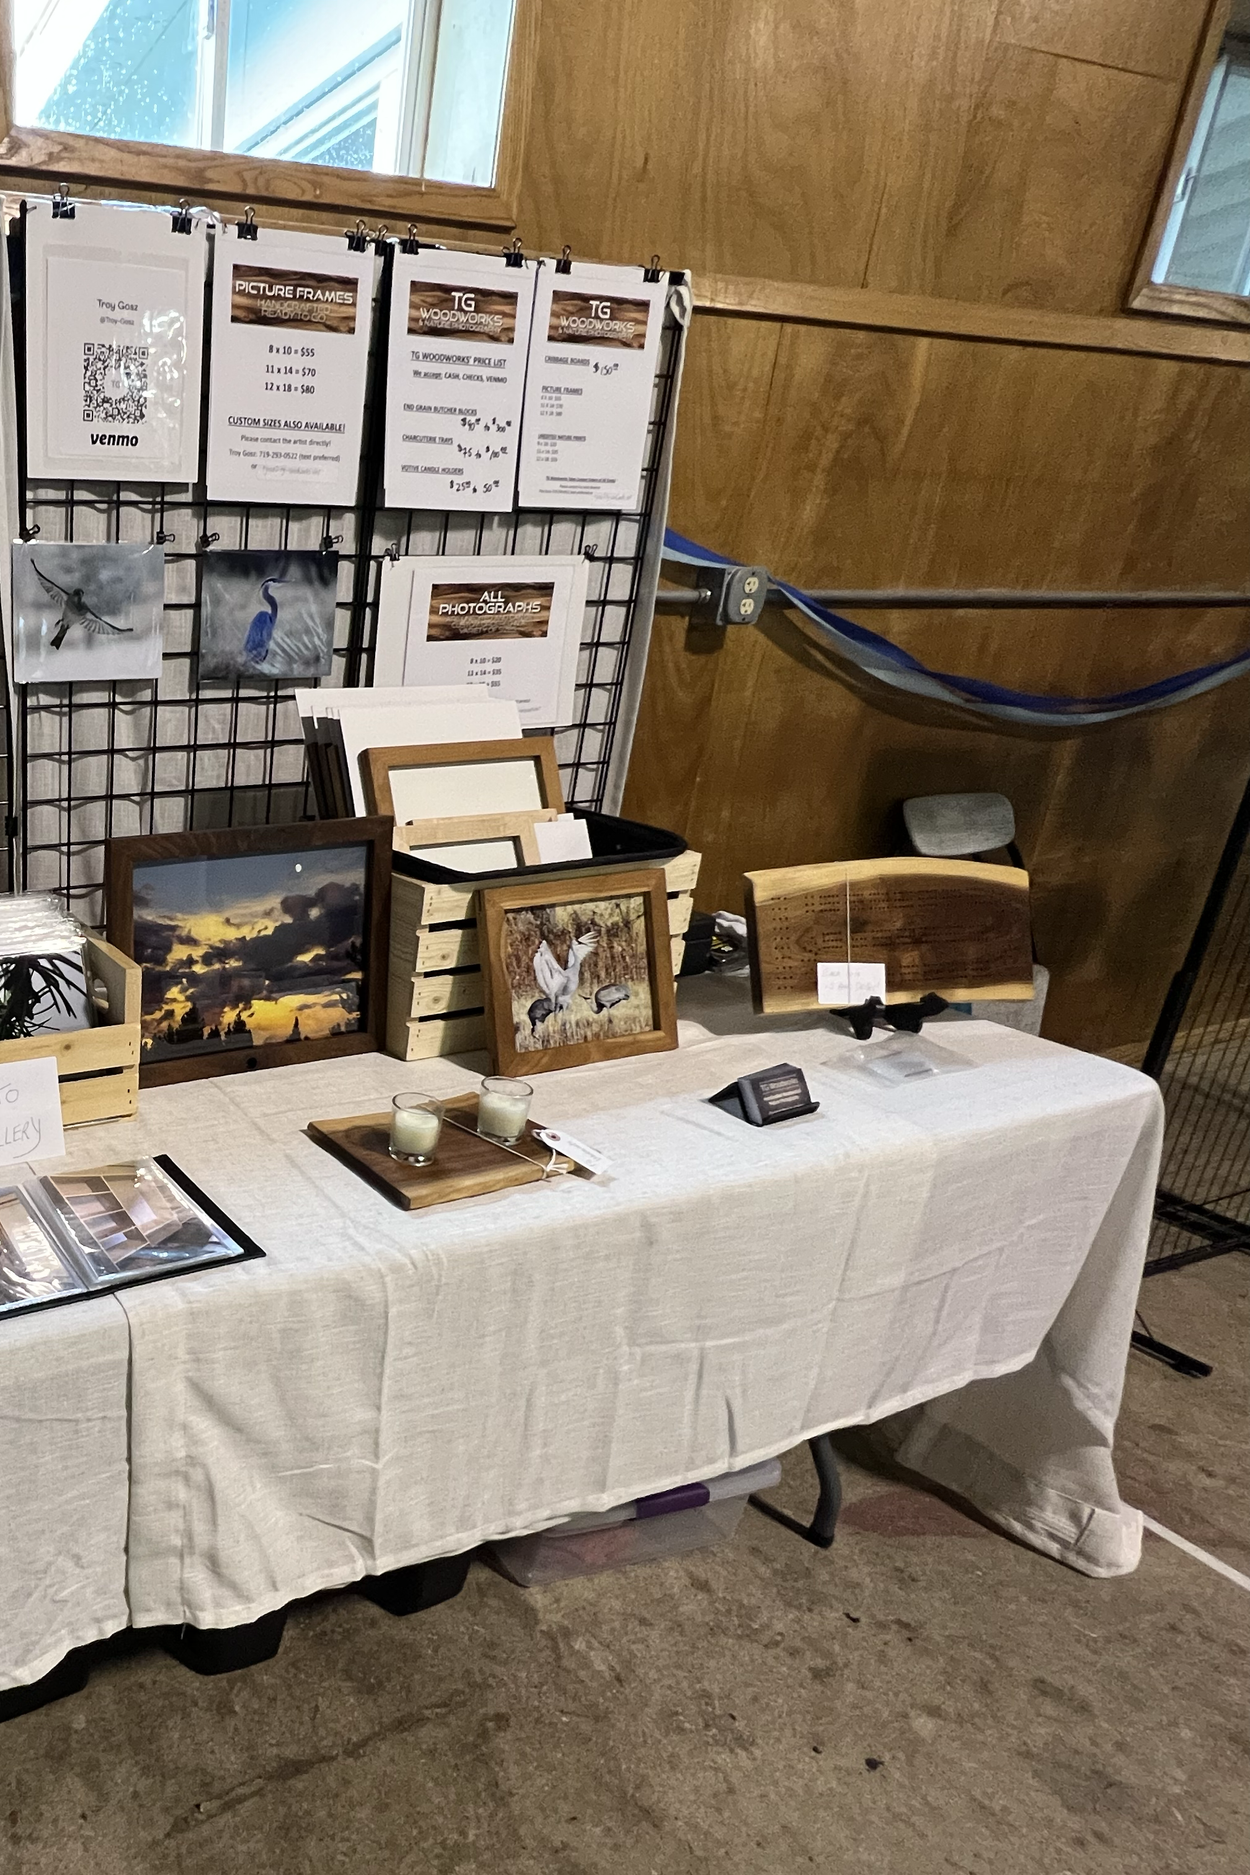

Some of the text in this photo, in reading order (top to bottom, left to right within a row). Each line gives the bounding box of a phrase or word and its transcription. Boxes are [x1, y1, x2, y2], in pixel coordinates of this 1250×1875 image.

[235, 281, 353, 304] PICTURE FRAMES
[97, 299, 138, 311] Troy Gosz
[451, 291, 476, 311] TG
[589, 300, 611, 319] TG
[419, 307, 503, 326] WOODWORKS
[560, 316, 635, 332] WOODWORKS
[268, 344, 274, 354] 8
[283, 345, 292, 355] 10
[301, 346, 315, 357] $55
[411, 351, 420, 359] TG
[473, 356, 492, 366] PRICE
[493, 359, 507, 367] LIST
[266, 364, 274, 374] 11
[284, 366, 293, 375] 14
[302, 367, 316, 377] $70
[413, 369, 422, 377] We
[486, 376, 507, 384] VENMO
[265, 382, 274, 391] 12
[283, 383, 292, 392] 18
[301, 384, 315, 394] $80
[403, 403, 477, 416] END GRAIN BUTCHER BLOCKS
[228, 416, 346, 432] CUSTOM SIZES ALSO AVAILABLE!
[90, 433, 139, 447] venmo
[241, 434, 258, 442] Please
[402, 434, 453, 445] CHARCUTERIE TRAYS
[229, 448, 241, 457] Troy
[401, 464, 464, 475] VOTIVE CANDLE HOLDERS
[480, 591, 505, 602] ALL
[438, 601, 541, 615] PHOTOGRAPHS
